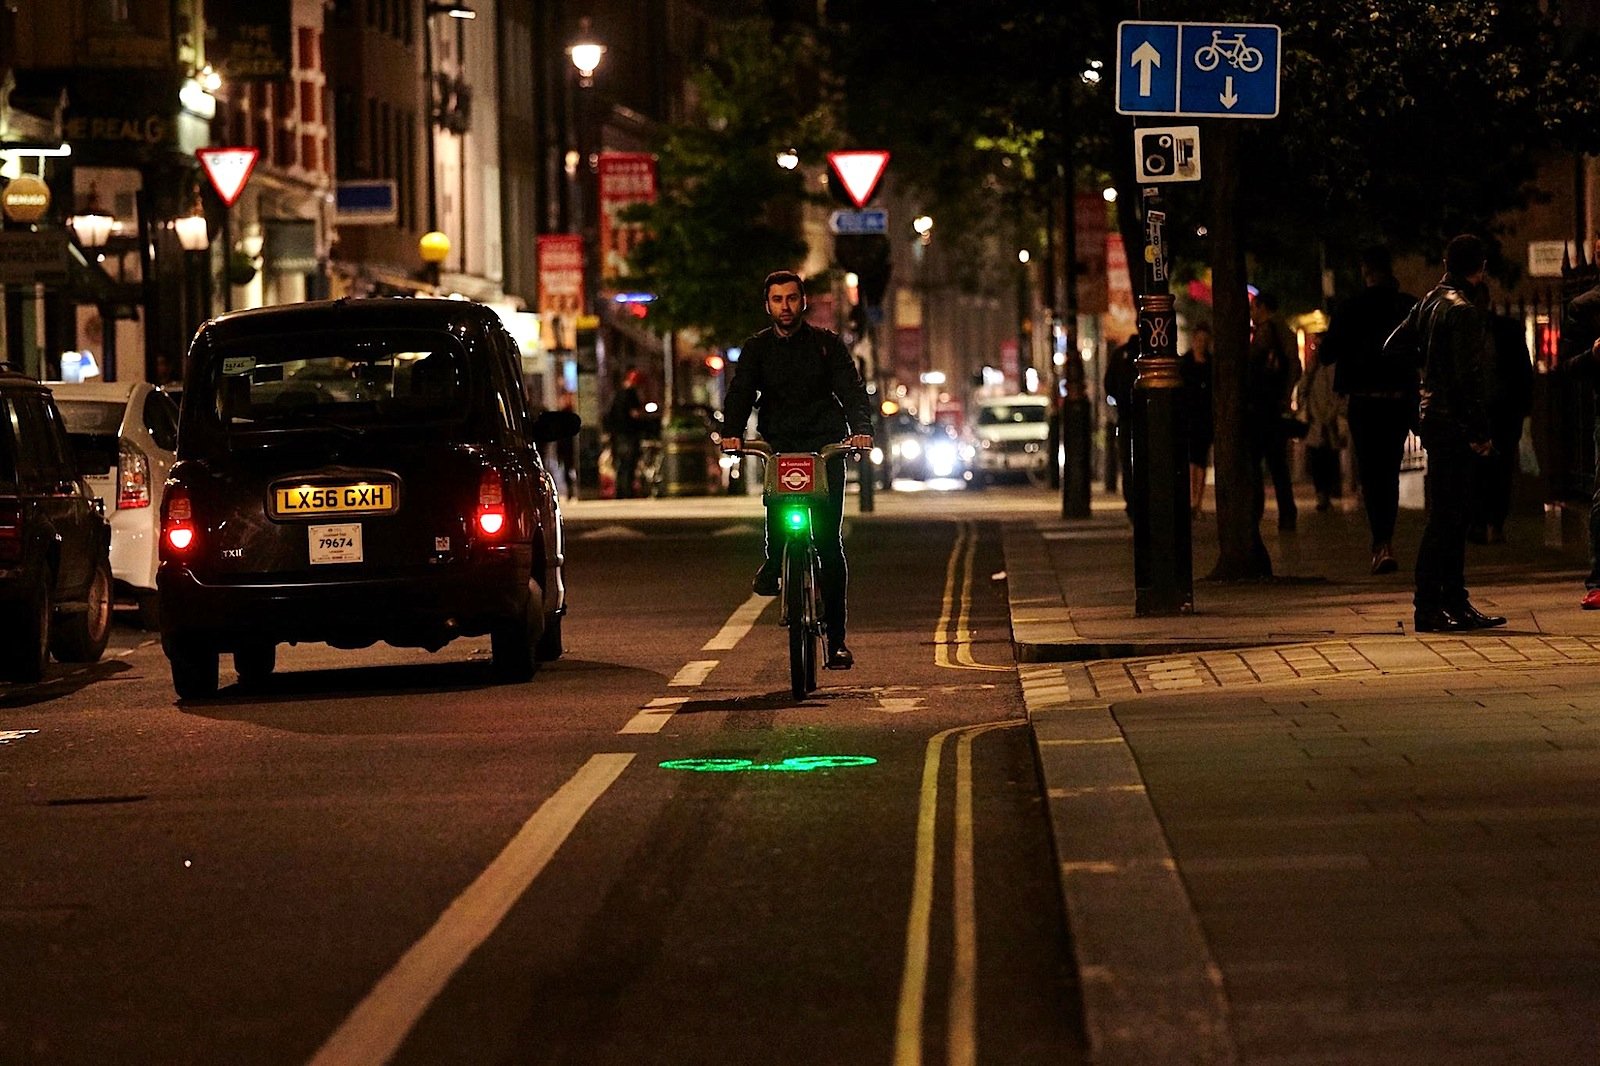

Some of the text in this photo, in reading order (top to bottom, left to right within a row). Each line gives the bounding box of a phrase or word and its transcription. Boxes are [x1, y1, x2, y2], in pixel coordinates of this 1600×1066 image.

[285, 487, 384, 509] LX56 GXH
[319, 537, 353, 549] 79674
